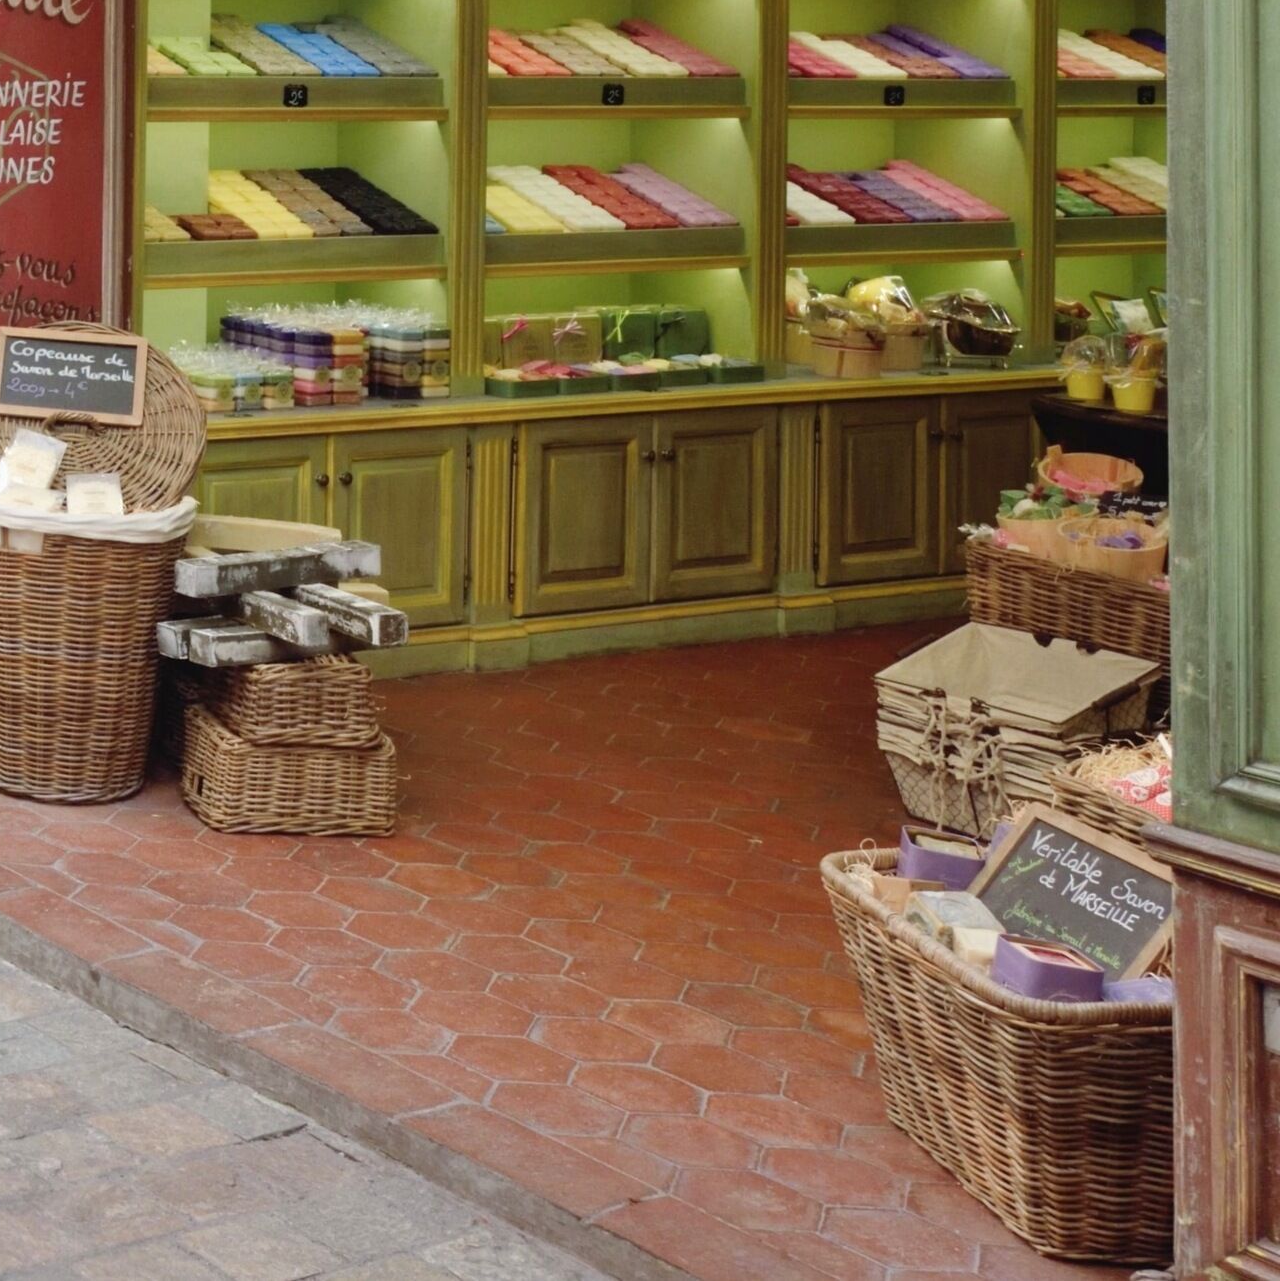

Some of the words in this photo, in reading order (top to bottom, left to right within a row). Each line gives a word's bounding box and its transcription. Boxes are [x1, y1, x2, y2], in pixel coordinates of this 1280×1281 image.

[104, 353, 128, 367] de
[10, 361, 54, 377] Savon
[58, 366, 78, 378] de
[81, 366, 136, 384] Marseille
[6, 377, 46, 398] 200g
[1031, 829, 1103, 885] Veritable
[1110, 878, 1166, 920] Savon
[1039, 869, 1057, 890] de
[1060, 874, 1140, 932] MARSEILLE
